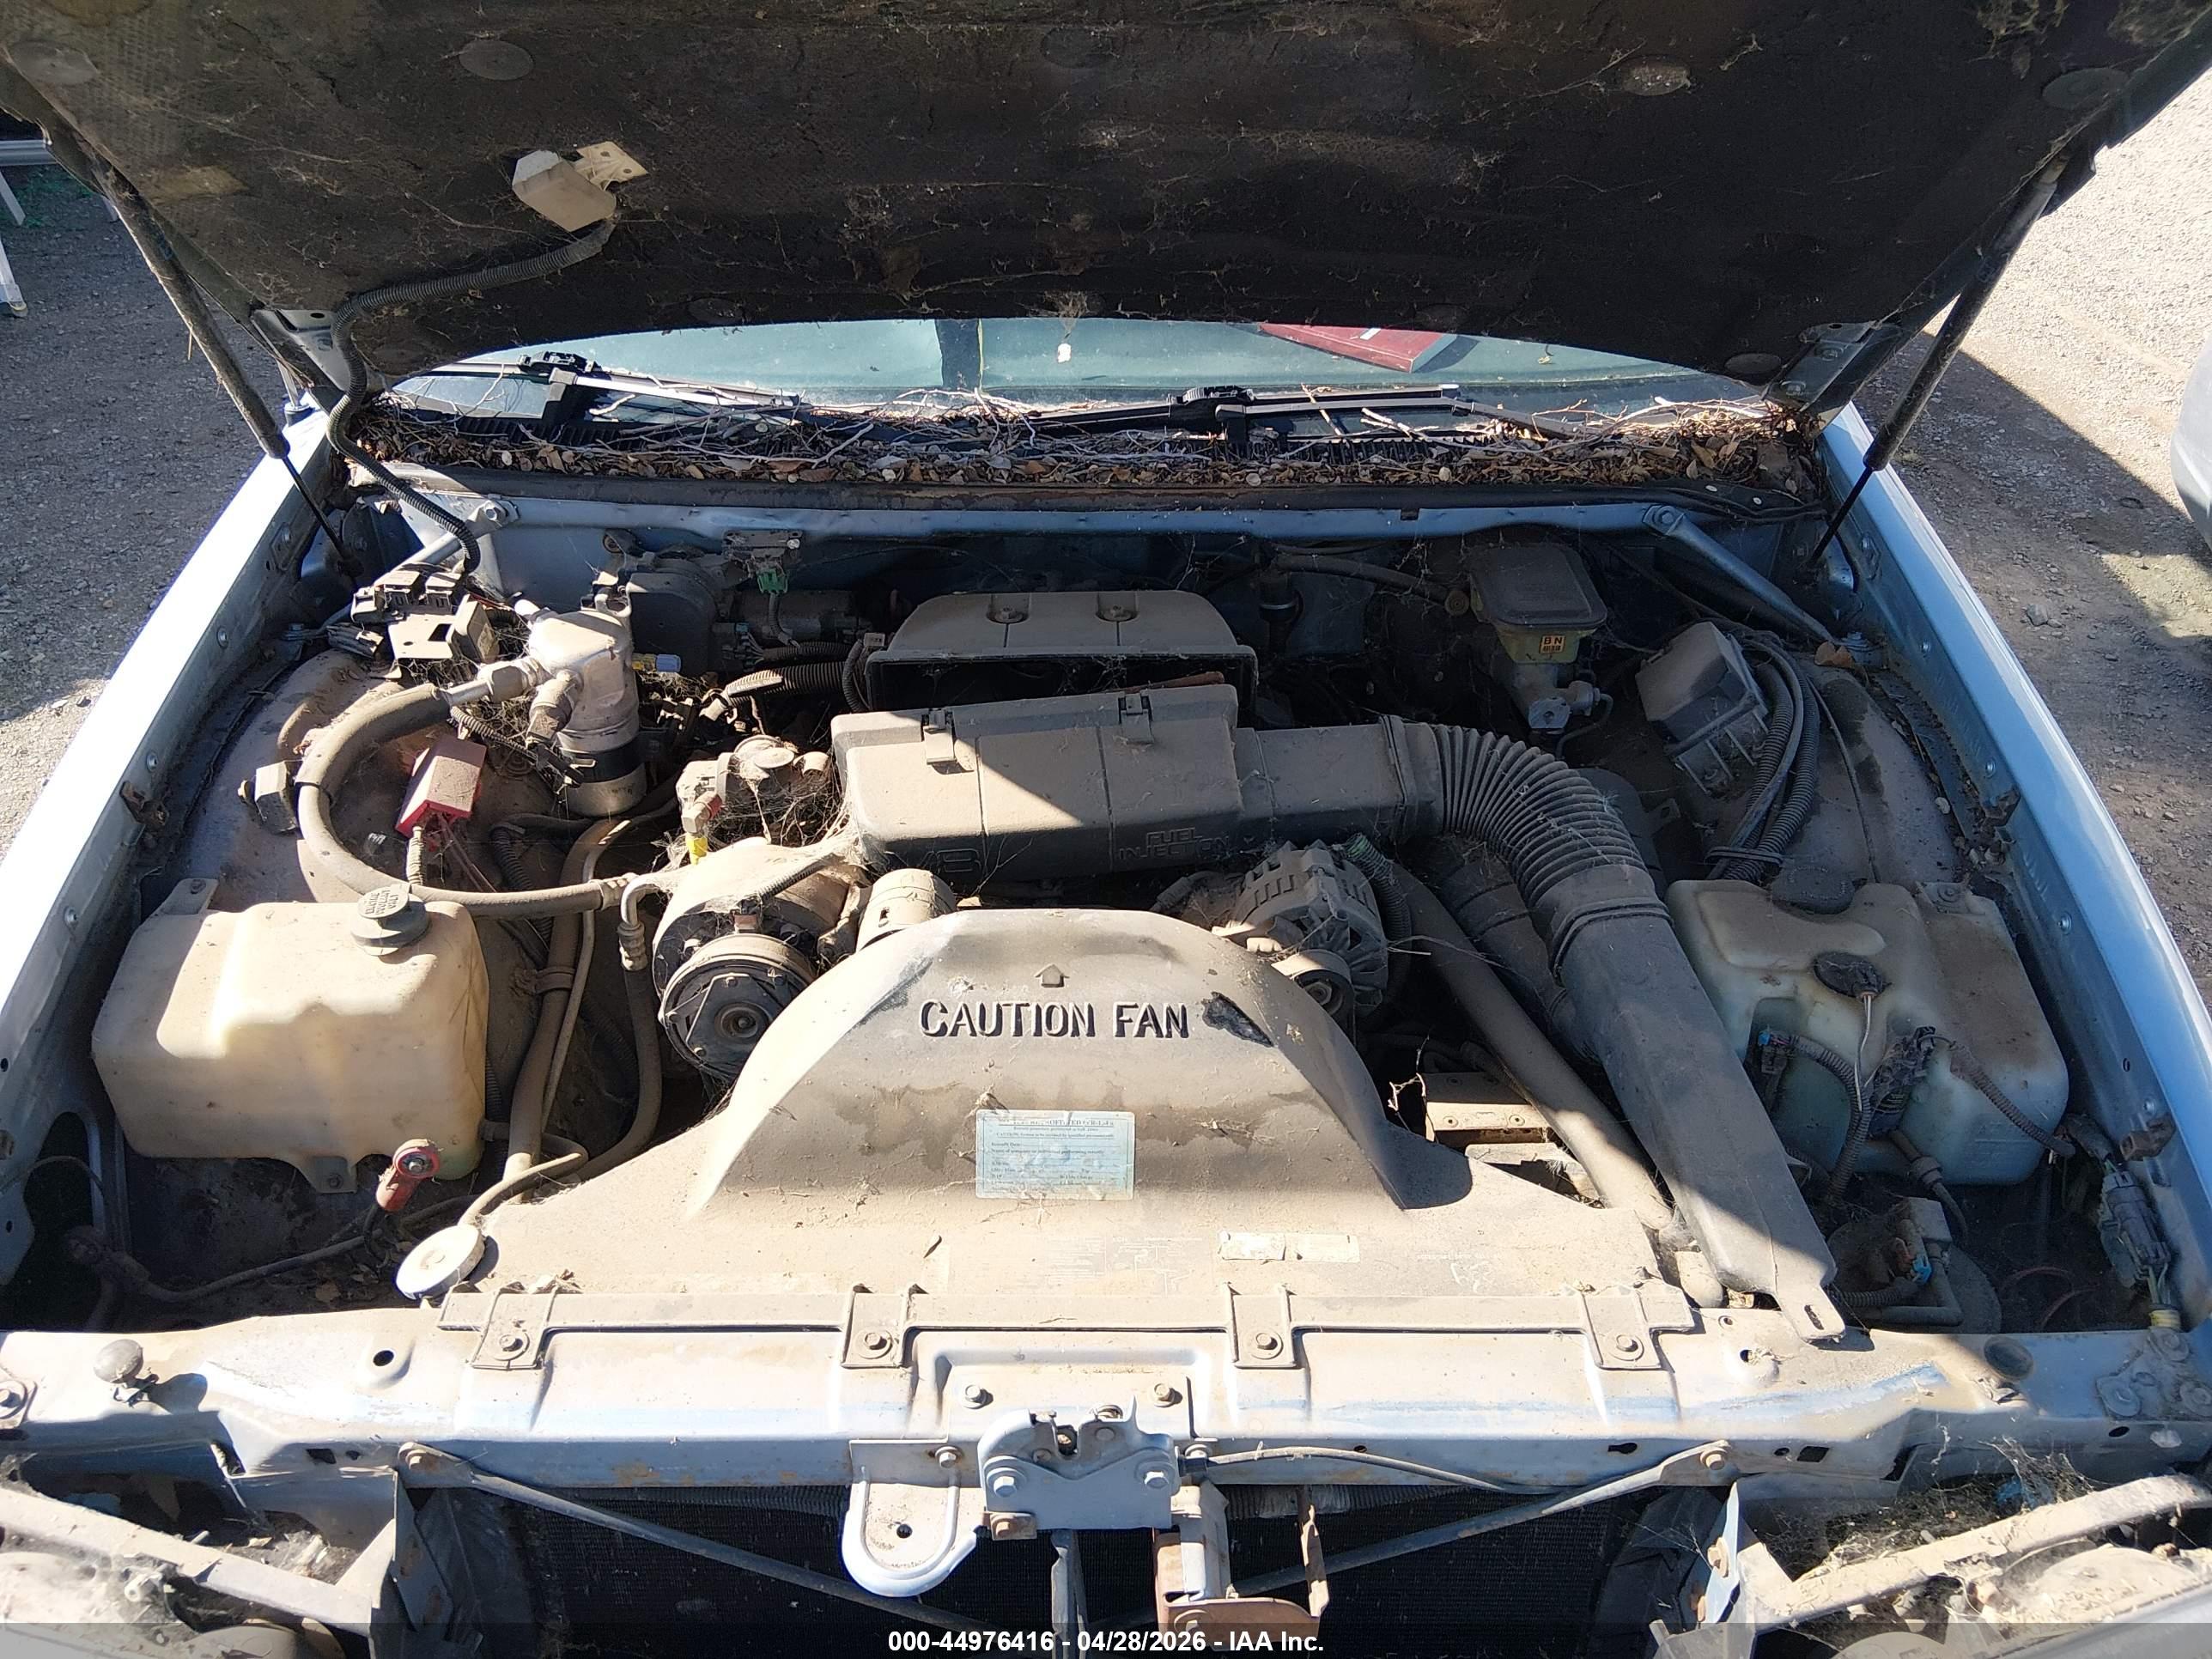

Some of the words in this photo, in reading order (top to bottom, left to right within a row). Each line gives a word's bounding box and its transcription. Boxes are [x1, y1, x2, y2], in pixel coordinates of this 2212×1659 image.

[1119, 836, 1230, 860] INJECTION
[1147, 827, 1203, 848] FUEL
[921, 1000, 1096, 1037] CAUTION
[1113, 1002, 1189, 1038] FAN
